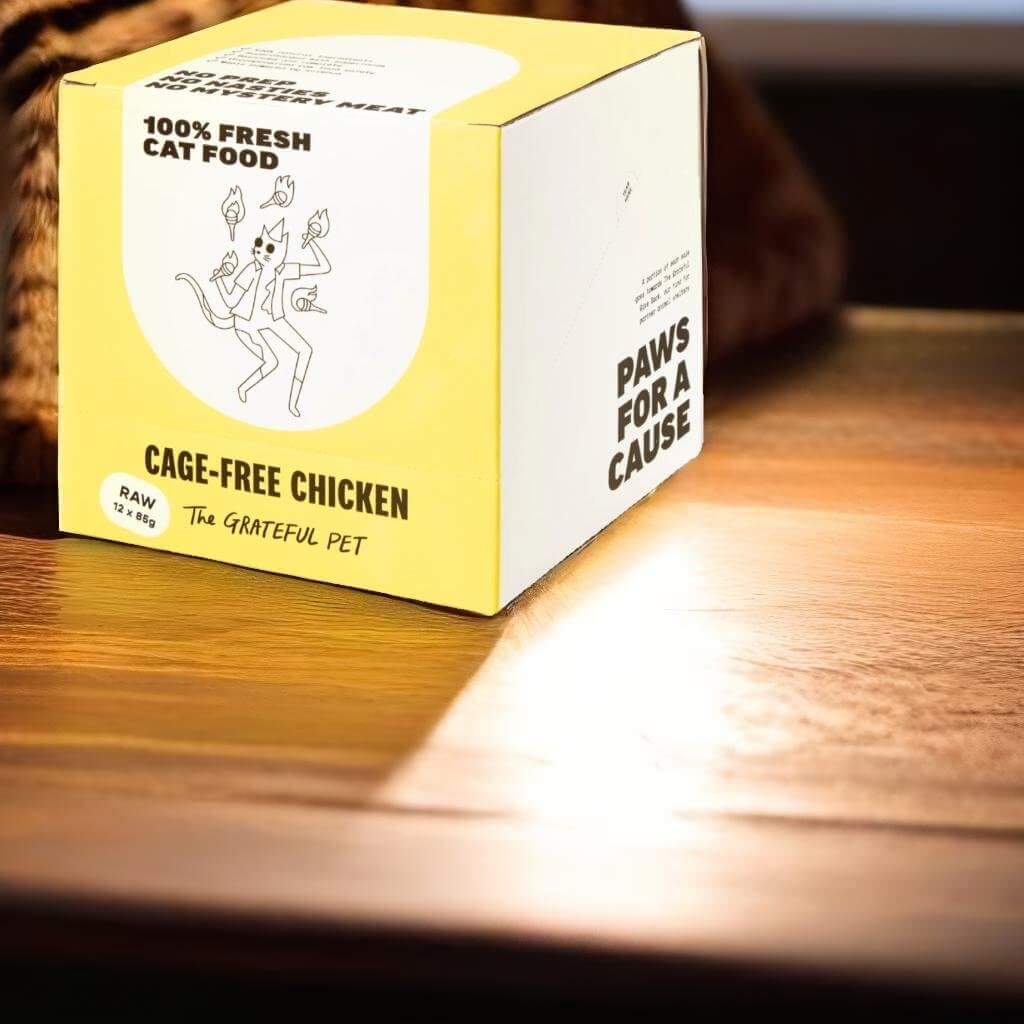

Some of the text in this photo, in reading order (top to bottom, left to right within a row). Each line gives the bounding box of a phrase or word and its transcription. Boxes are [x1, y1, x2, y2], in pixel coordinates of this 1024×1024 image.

[159, 75, 330, 98] NO NASTIES
[175, 70, 297, 86] NO PREP
[144, 81, 427, 115] NO MYSTERY MEAT
[143, 115, 312, 152] 100% FRESH
[143, 137, 279, 170] CAT FOOD
[617, 316, 690, 399] PAWS
[617, 359, 690, 443] FOR A
[608, 398, 690, 491] CAUSE
[119, 485, 156, 510] RAW
[144, 444, 409, 521] CAGE-FREE CHICKEN
[113, 501, 156, 529] 12 x 85g
[182, 505, 368, 556] The GRATEFUL PET
